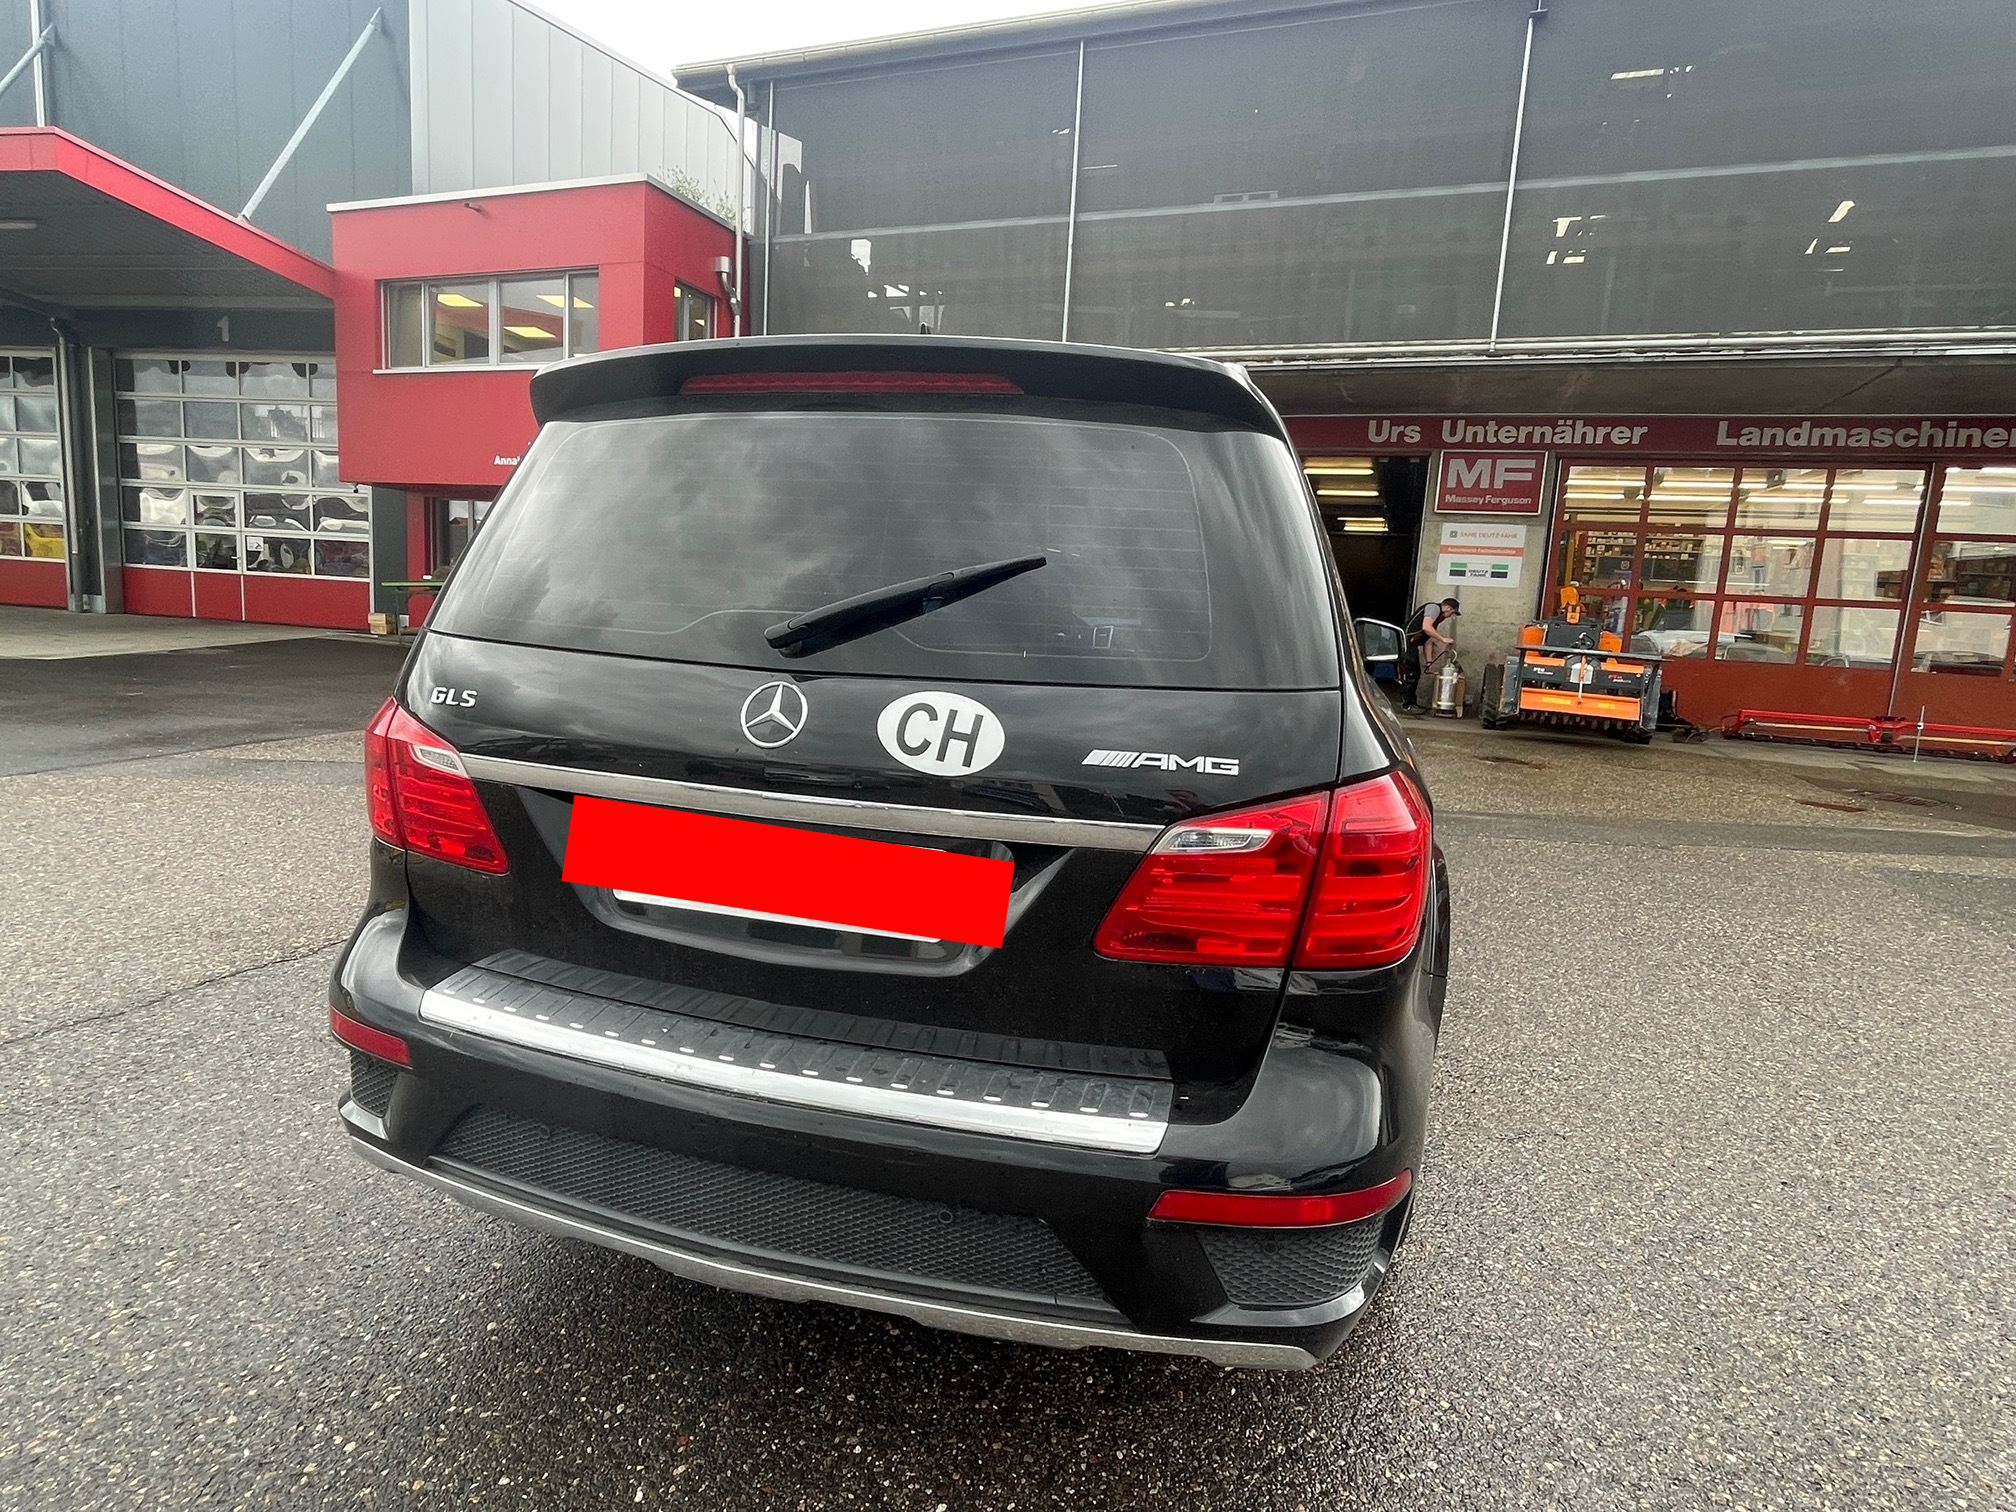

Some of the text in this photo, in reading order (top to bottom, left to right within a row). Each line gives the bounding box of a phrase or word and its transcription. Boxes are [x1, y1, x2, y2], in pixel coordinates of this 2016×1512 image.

[217, 315, 229, 342] 1
[1368, 419, 1649, 445] Urs Unternährer
[1446, 458, 1536, 489] MF
[1445, 494, 1532, 506] Massey Ferguson
[431, 686, 478, 708] GLS
[896, 702, 984, 768] CH
[1131, 752, 1239, 776] AMG
